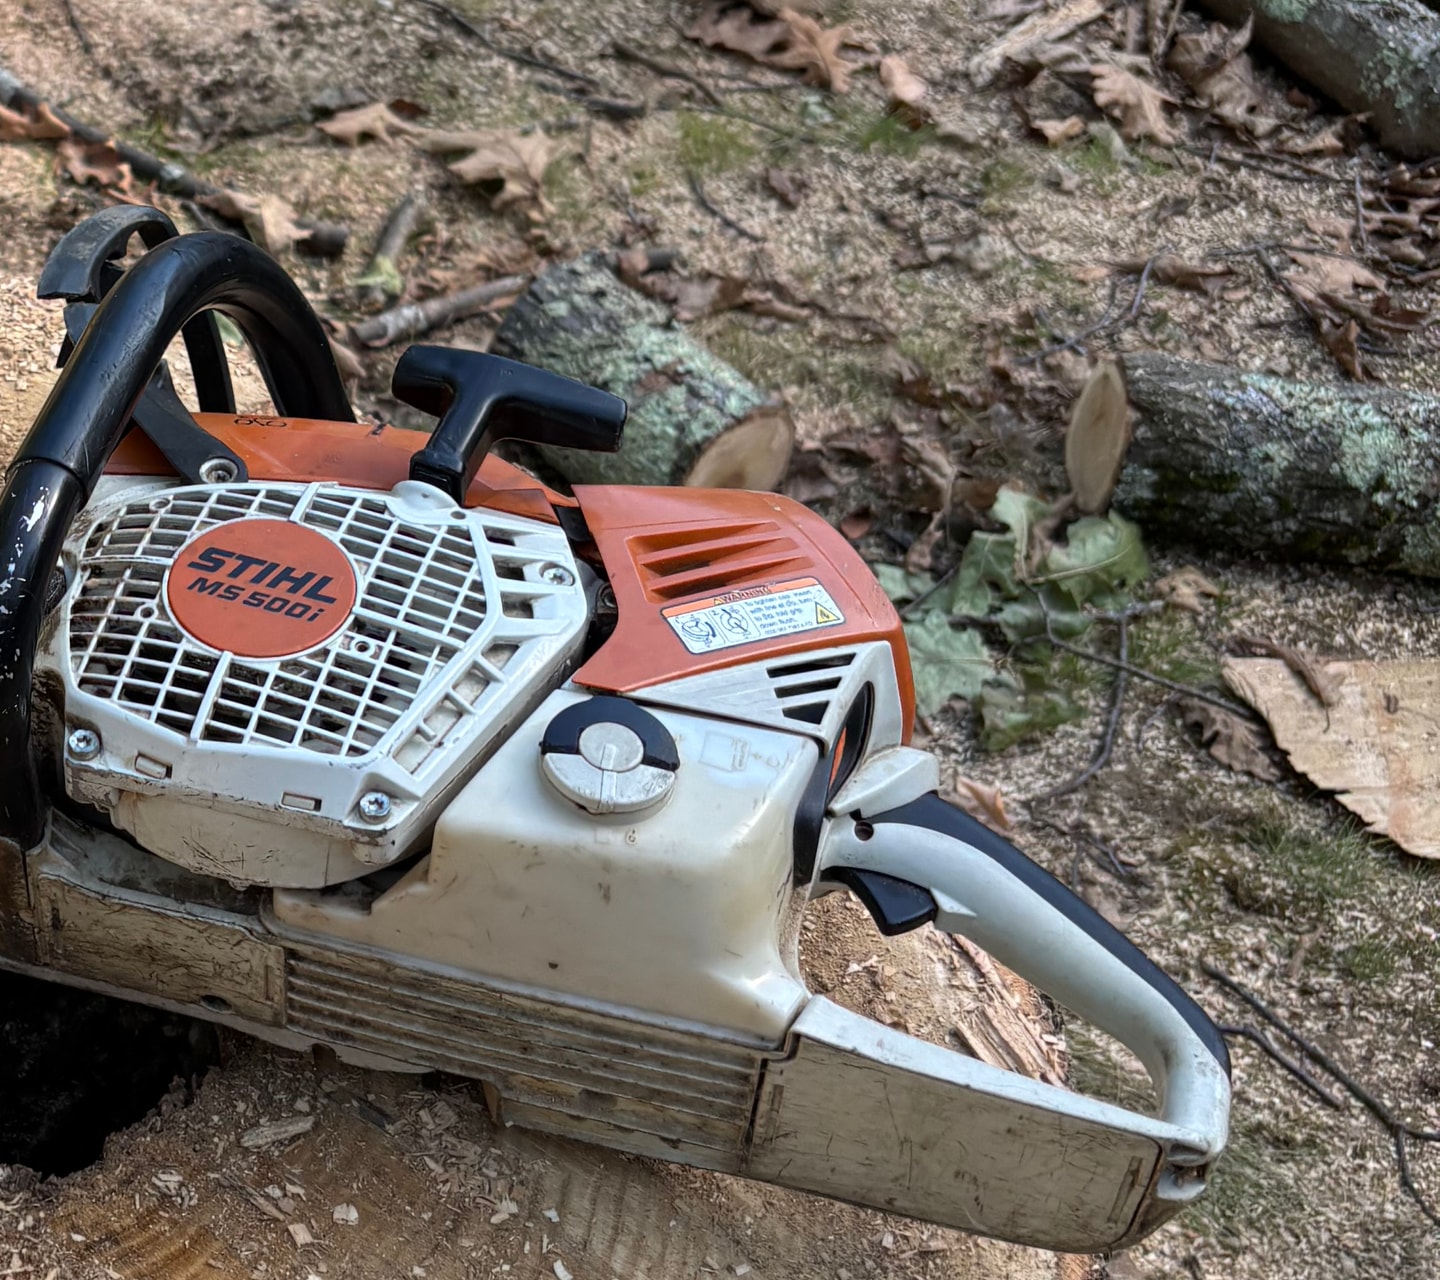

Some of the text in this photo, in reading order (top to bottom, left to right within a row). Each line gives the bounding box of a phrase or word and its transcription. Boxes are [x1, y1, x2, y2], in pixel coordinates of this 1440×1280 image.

[187, 577, 325, 622] MS 500i
[188, 547, 337, 604] STIHL
